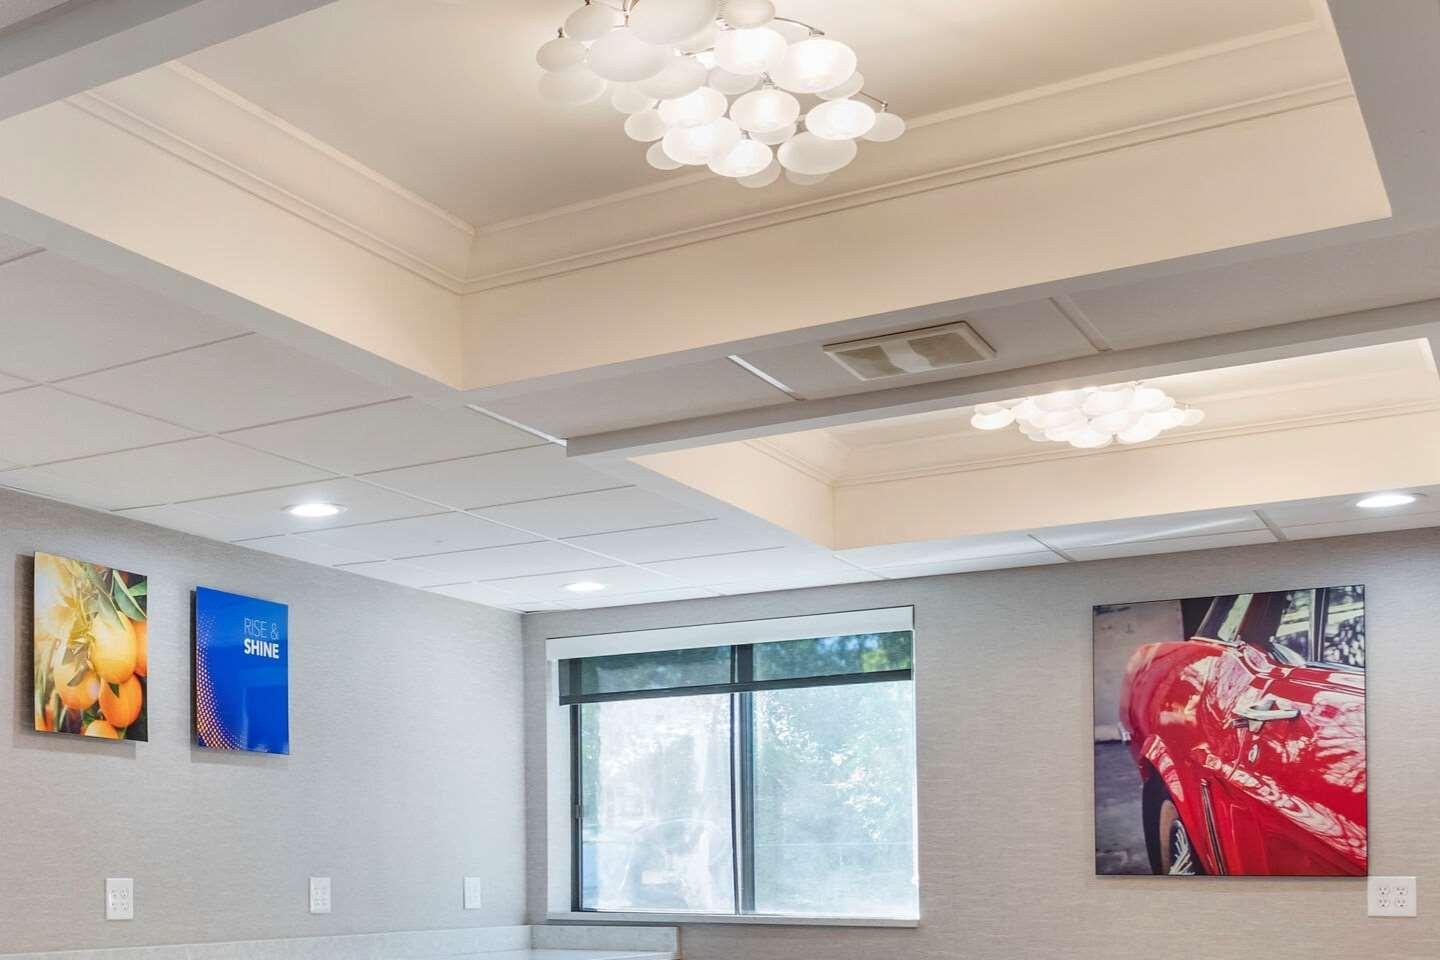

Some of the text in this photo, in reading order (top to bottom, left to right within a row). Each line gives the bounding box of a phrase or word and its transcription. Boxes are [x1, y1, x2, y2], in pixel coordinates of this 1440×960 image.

[244, 617, 279, 640] RISE &
[244, 638, 280, 659] SHINE
